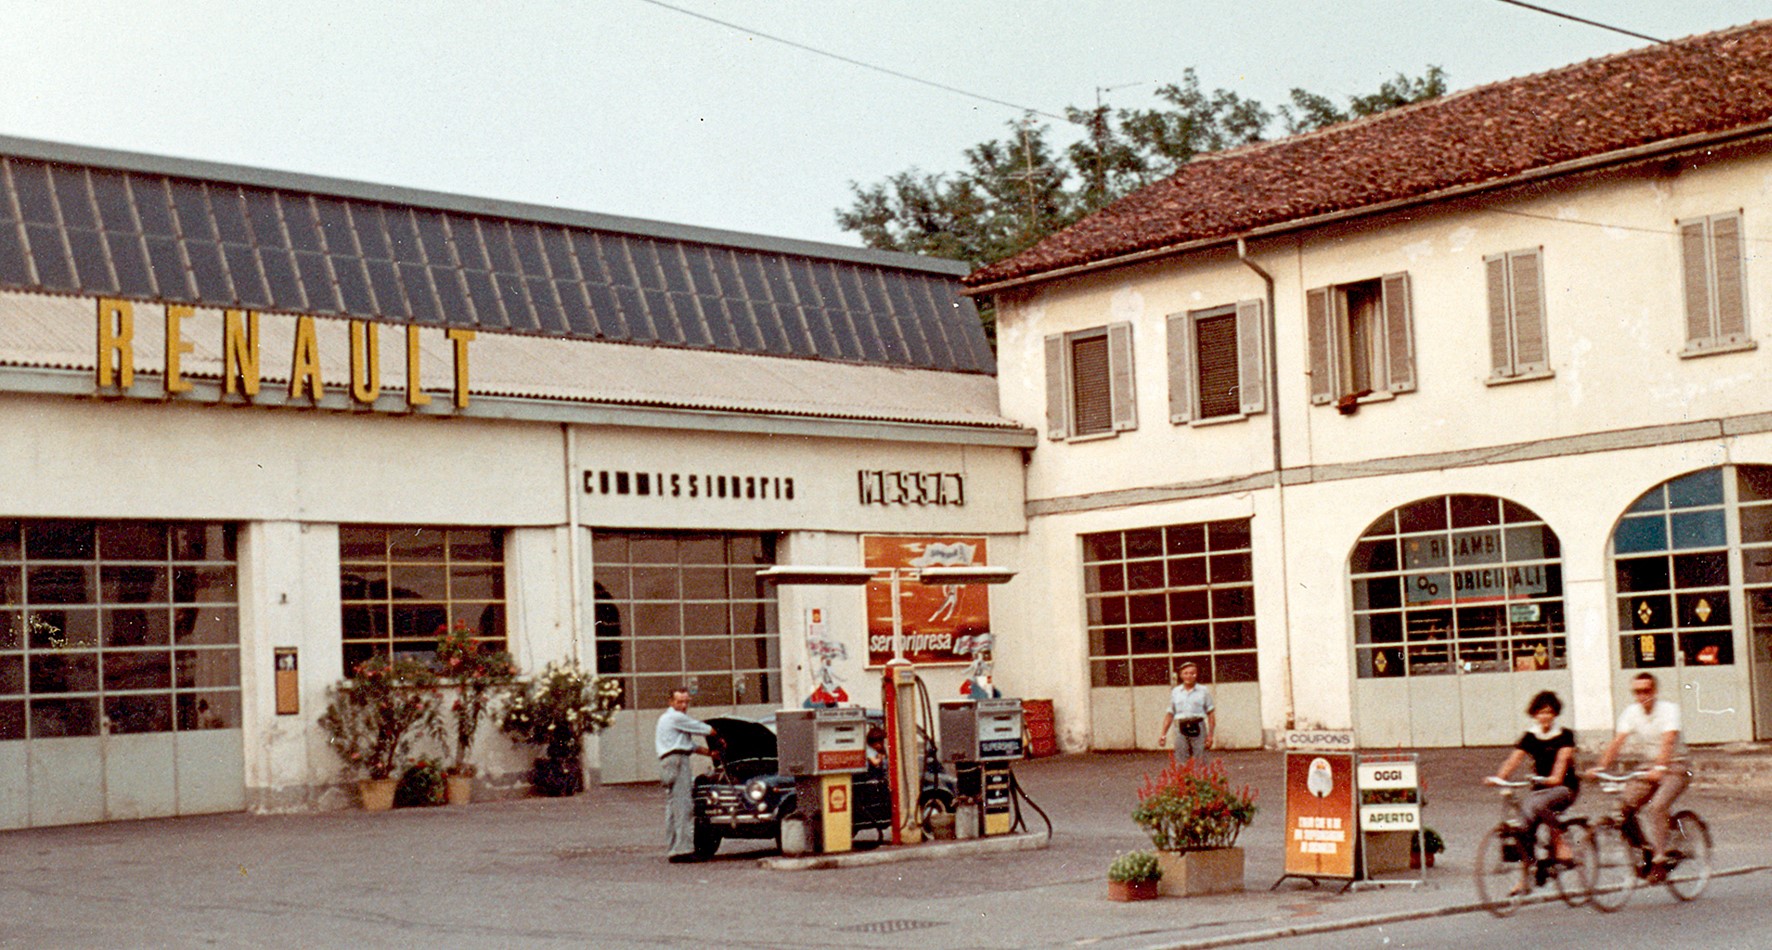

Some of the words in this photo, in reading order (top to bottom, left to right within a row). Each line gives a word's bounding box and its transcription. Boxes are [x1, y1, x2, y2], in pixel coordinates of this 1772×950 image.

[97, 298, 476, 409] RENAULT
[1290, 734, 1350, 744] COUPONS
[1374, 771, 1402, 781] OGGI
[1369, 813, 1415, 823] APERTO
